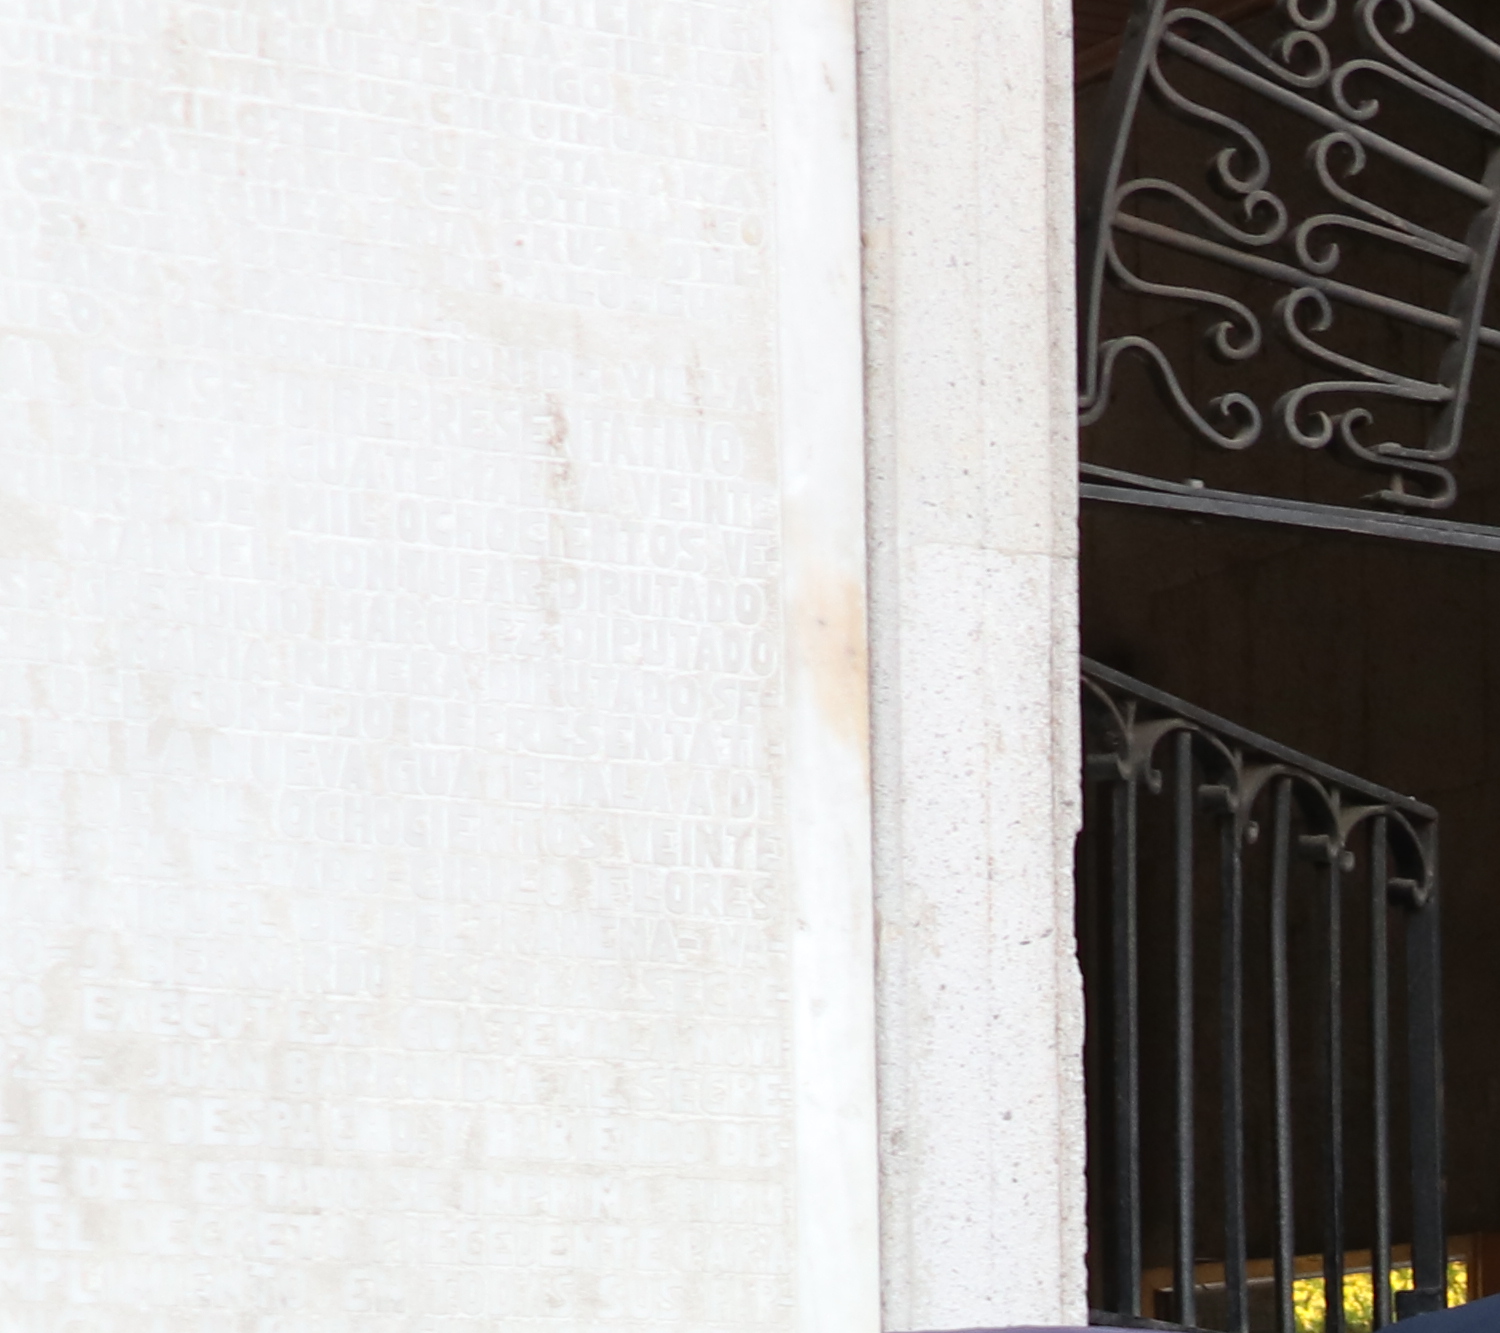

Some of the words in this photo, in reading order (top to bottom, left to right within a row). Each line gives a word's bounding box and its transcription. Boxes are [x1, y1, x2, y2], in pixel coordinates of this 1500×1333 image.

[559, 563, 765, 626] DIPUTADO
[563, 613, 780, 678] DIPUTADO
[144, 1040, 268, 1088] JUAN
[42, 1091, 143, 1141] DEL
